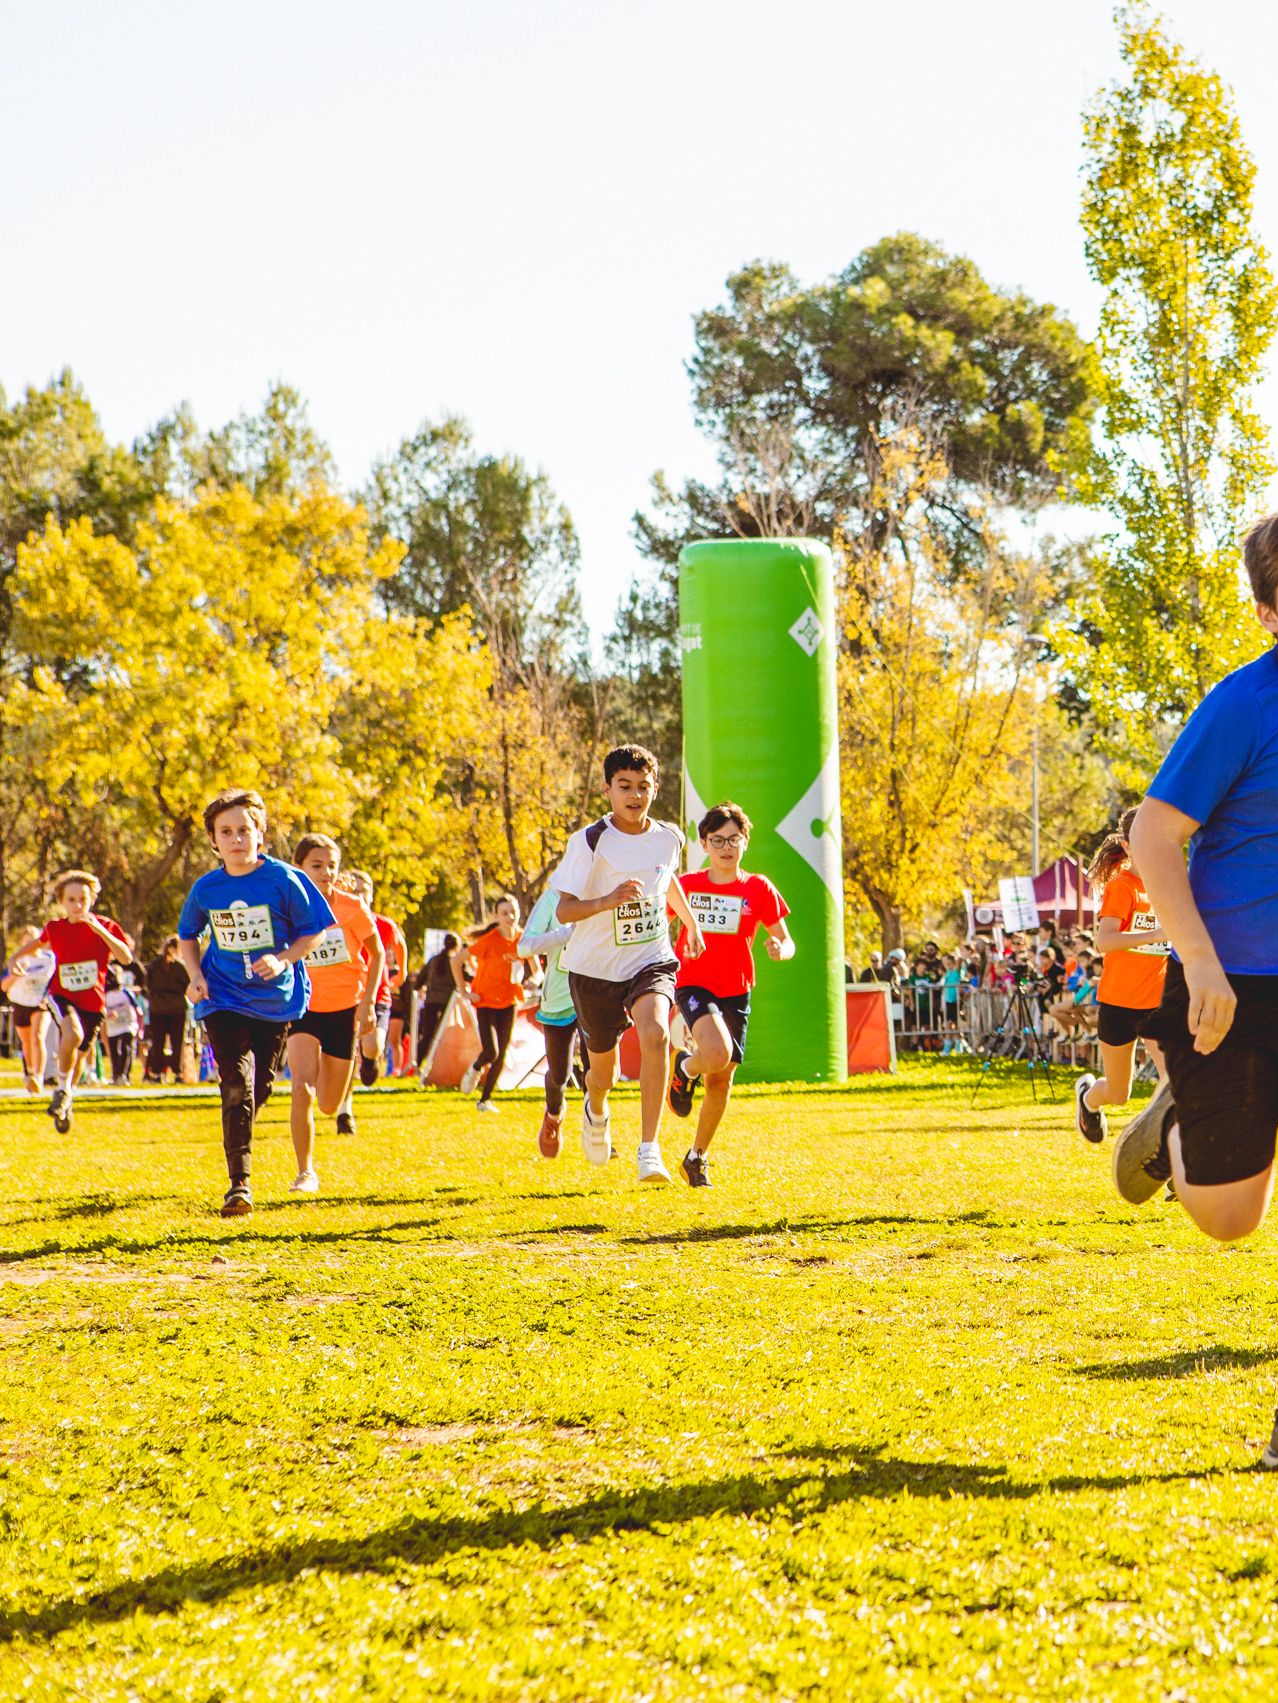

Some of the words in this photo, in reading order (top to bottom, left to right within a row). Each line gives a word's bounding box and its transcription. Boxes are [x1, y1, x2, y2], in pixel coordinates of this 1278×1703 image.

[691, 900, 710, 908] CROS
[618, 908, 641, 918] CROS
[221, 930, 261, 942] 1794
